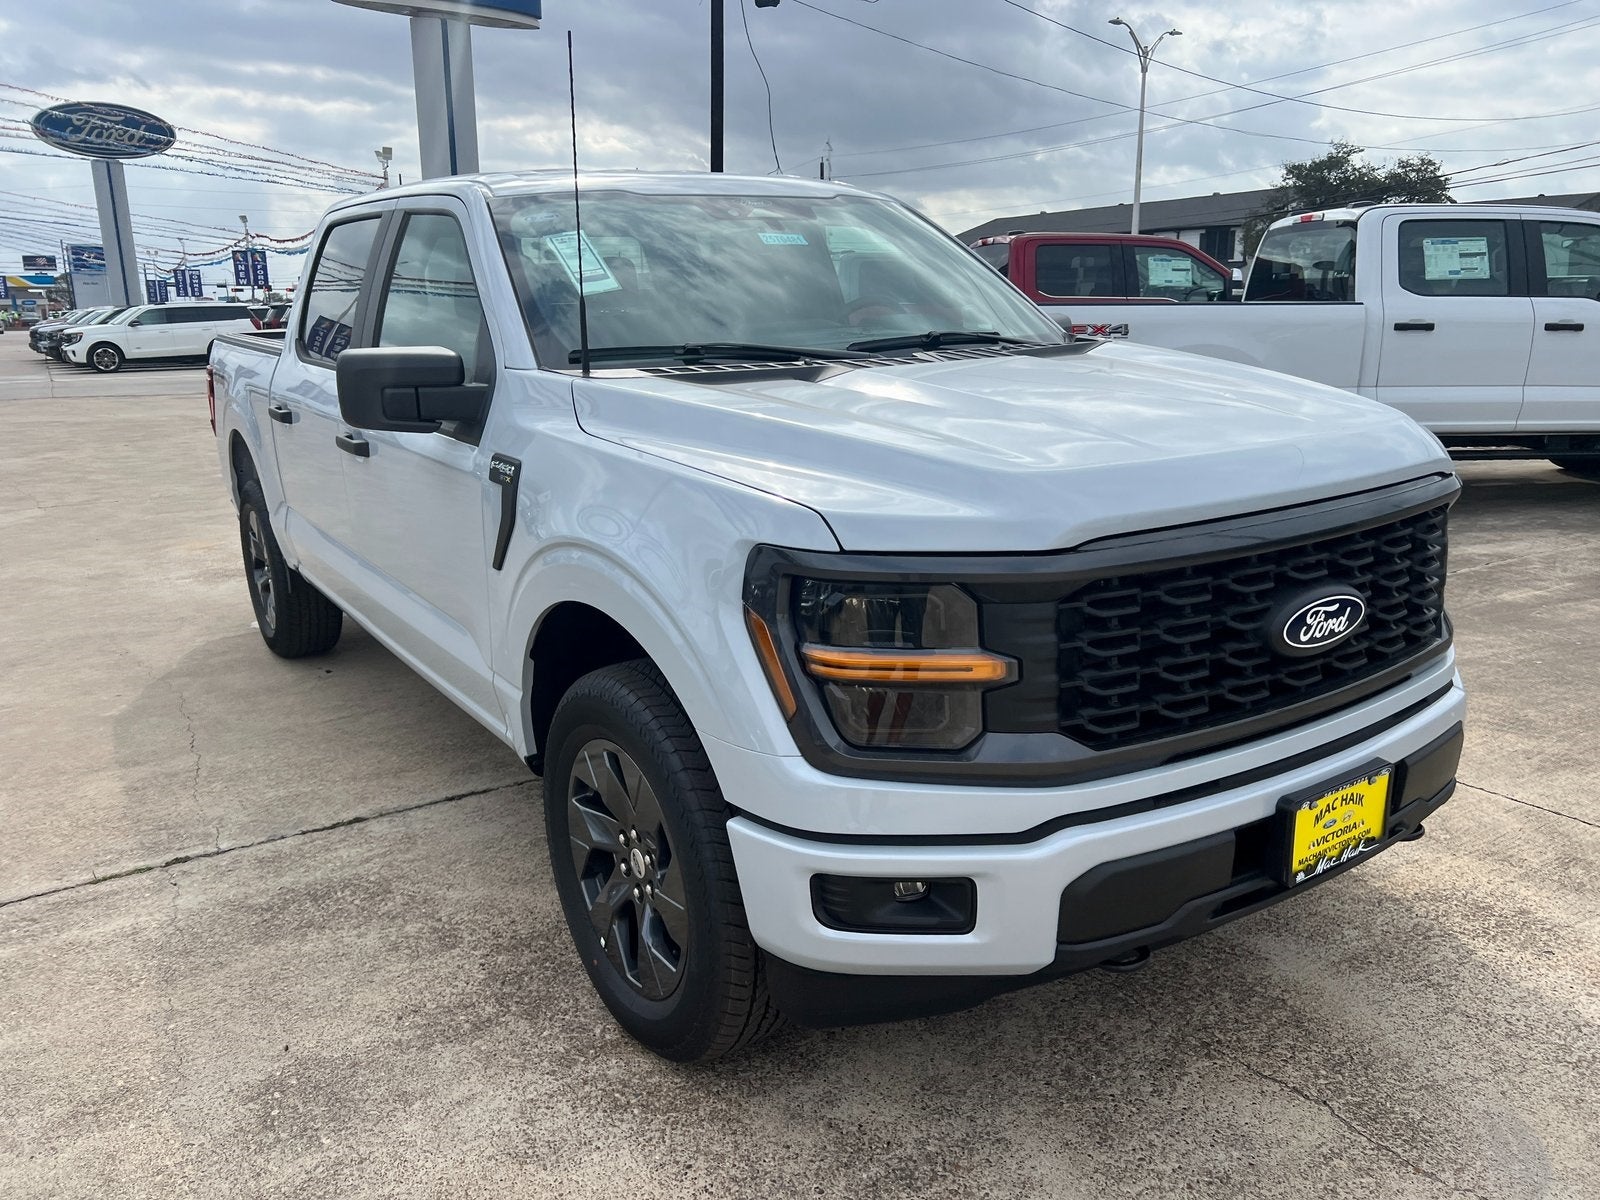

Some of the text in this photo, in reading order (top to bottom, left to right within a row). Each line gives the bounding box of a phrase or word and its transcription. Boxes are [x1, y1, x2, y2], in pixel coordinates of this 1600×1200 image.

[66, 112, 146, 145] Ford
[237, 264, 248, 285] NEW
[256, 265, 265, 285] FORD
[1071, 324, 1129, 336] FX4
[1299, 602, 1352, 642] Ford
[1313, 797, 1339, 828] MAC
[1340, 792, 1365, 807] HAIK
[1297, 828, 1372, 867] MACHAIKVICTORIA.COM
[1315, 822, 1357, 847] VICTORIA
[1314, 840, 1380, 875] Mac Haik
